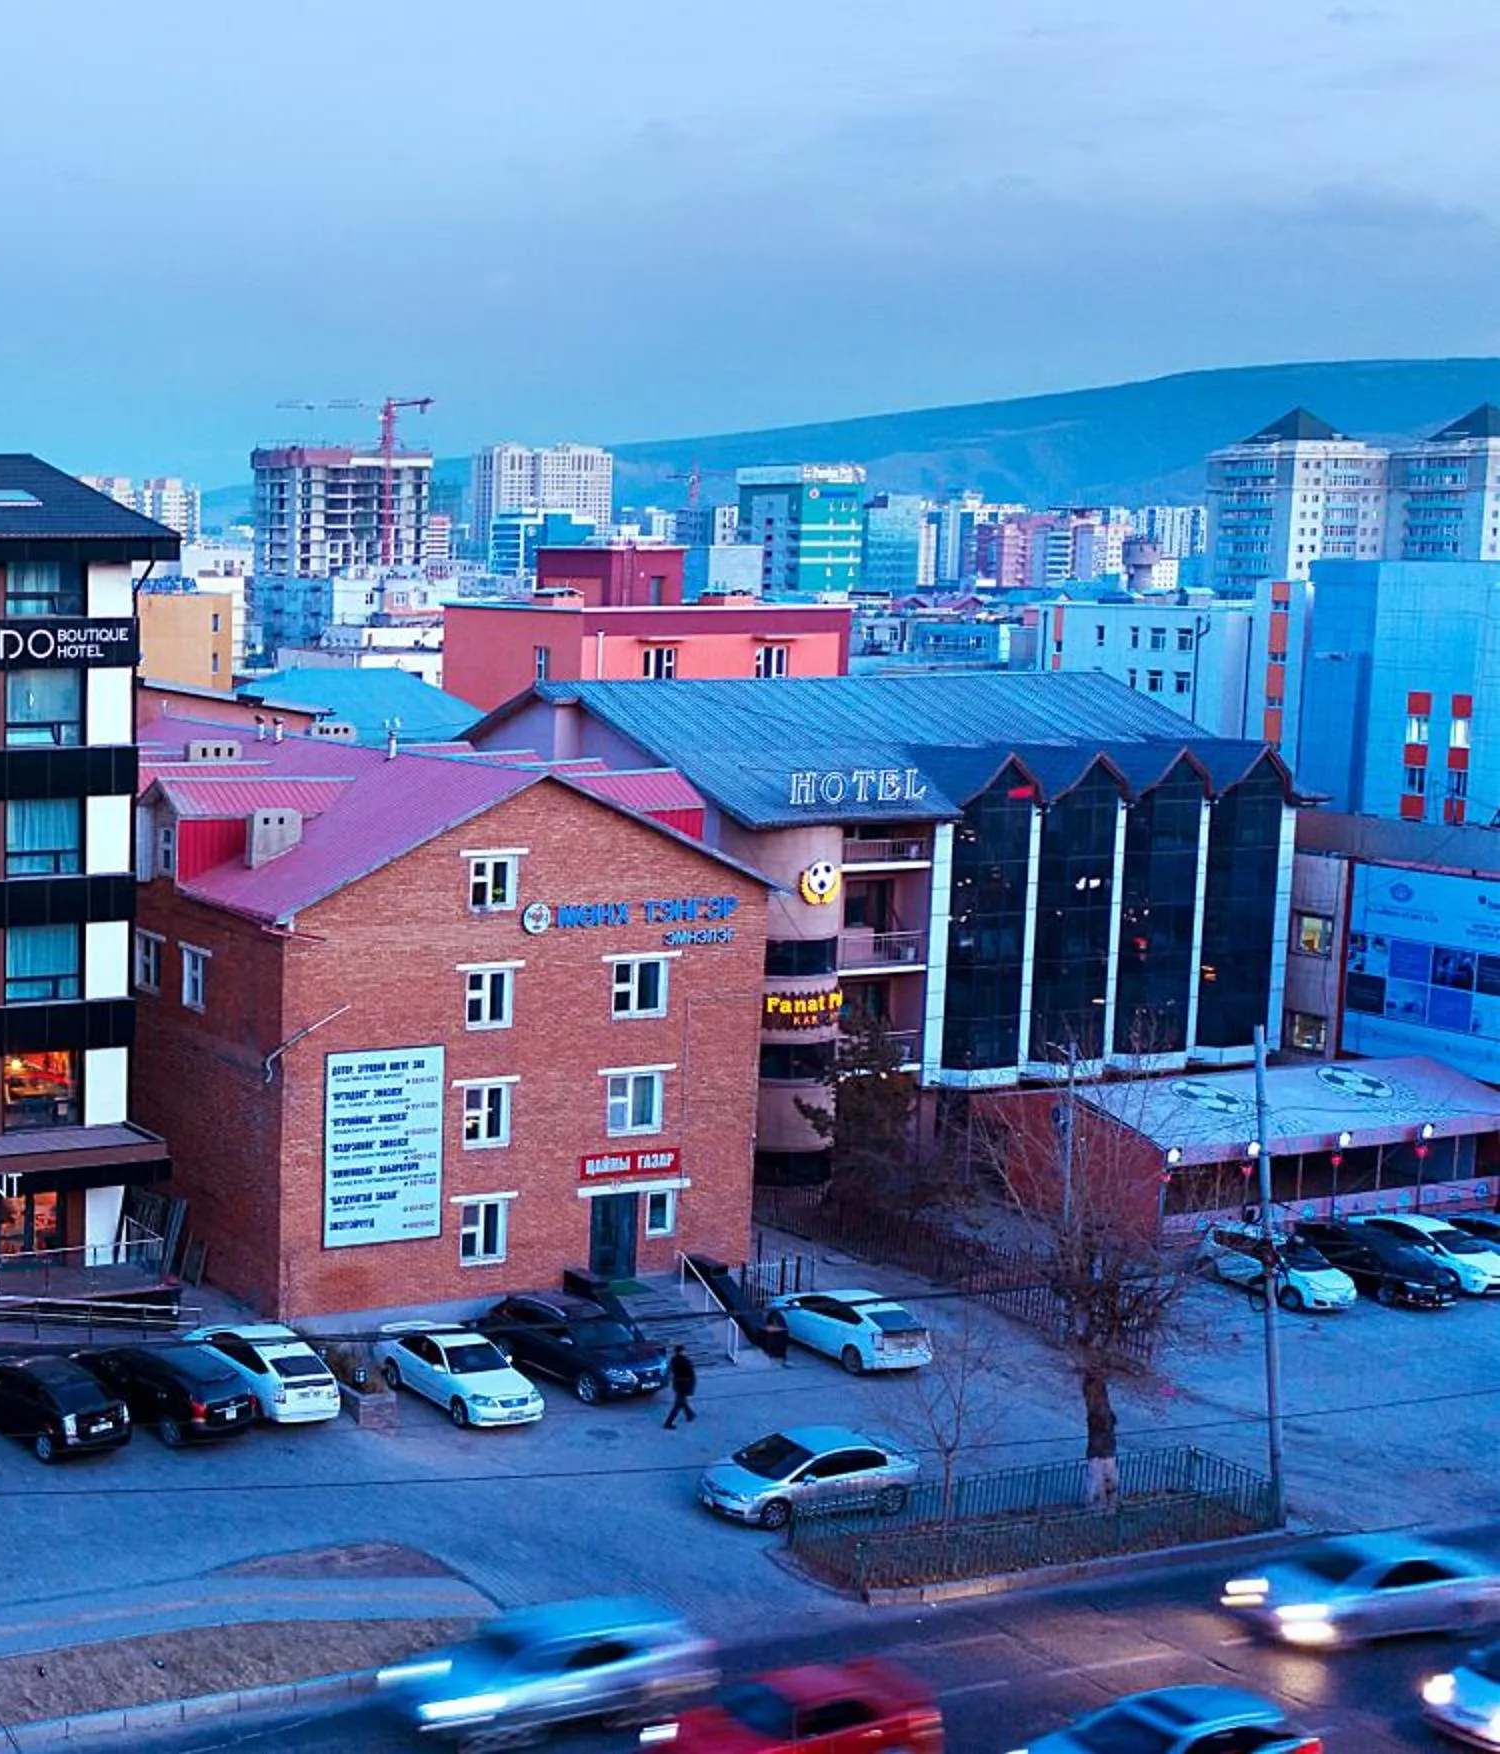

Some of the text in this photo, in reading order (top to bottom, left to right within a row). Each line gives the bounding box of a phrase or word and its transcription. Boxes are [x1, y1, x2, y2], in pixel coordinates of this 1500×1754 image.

[57, 627, 129, 643] BOUTIQUE
[57, 644, 105, 660] HOTEL
[789, 768, 929, 805] HOTEL
[642, 894, 741, 923] ТЭНГЭР
[637, 1153, 675, 1169] ГАЗАР
